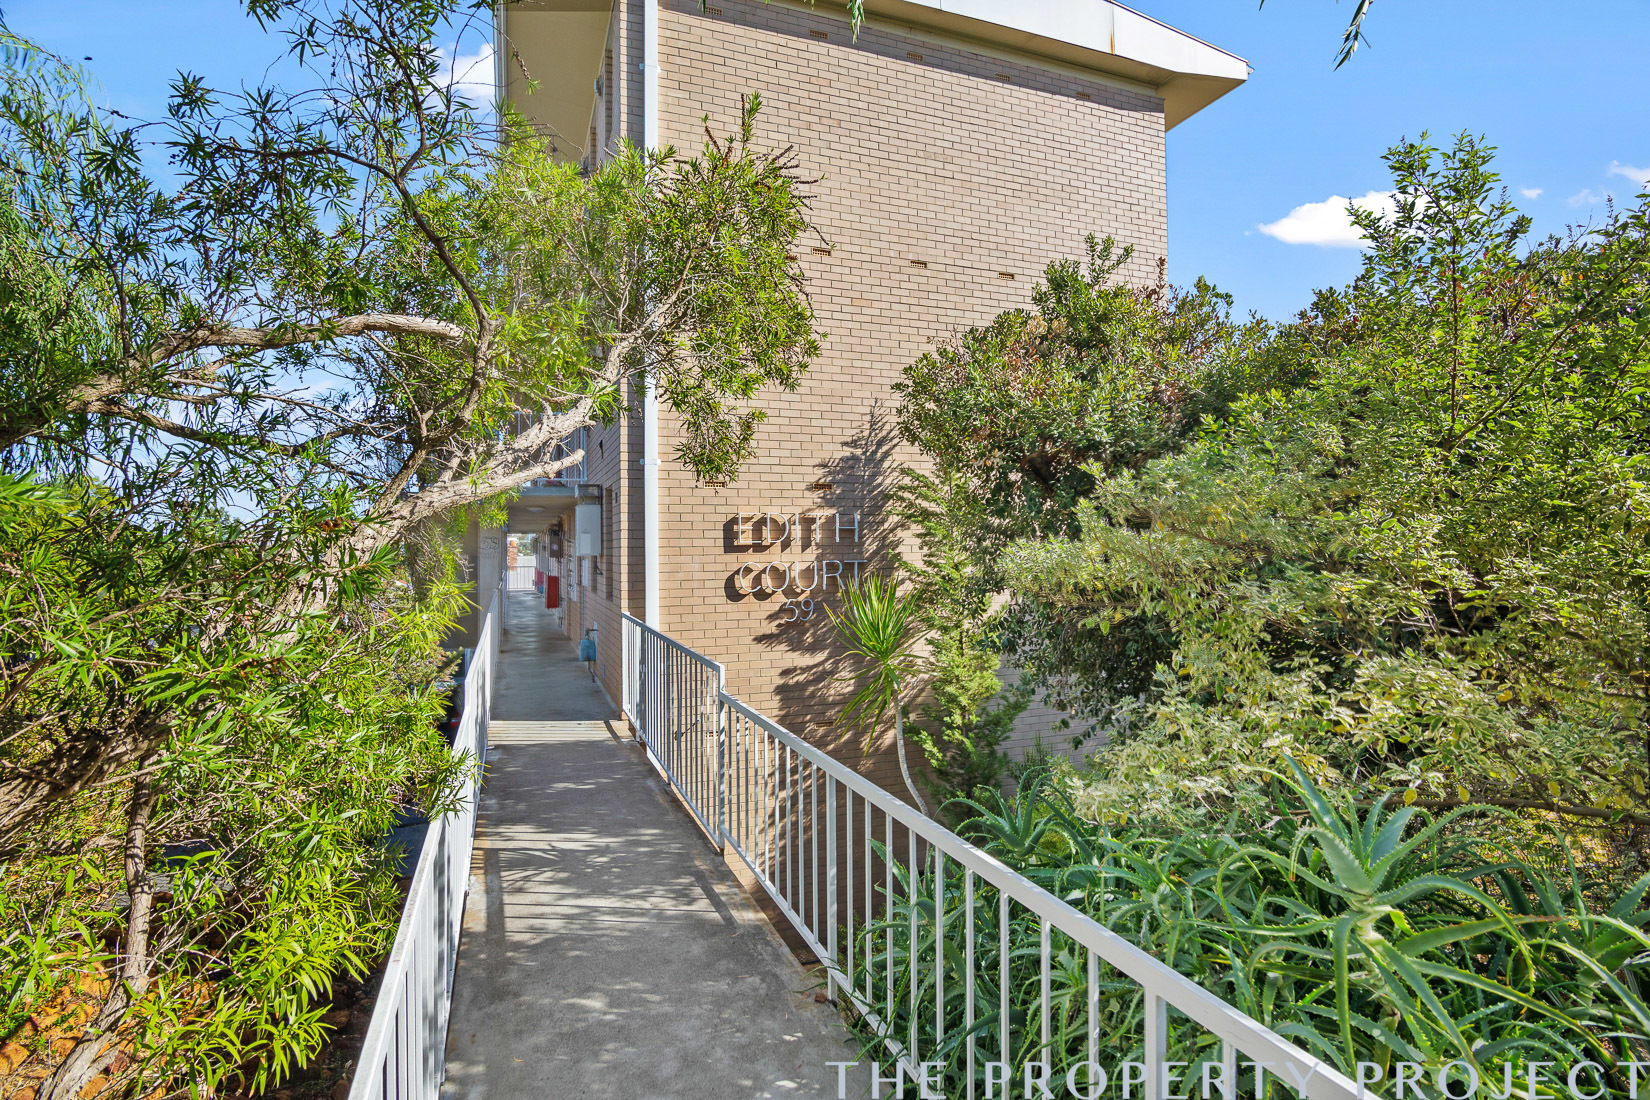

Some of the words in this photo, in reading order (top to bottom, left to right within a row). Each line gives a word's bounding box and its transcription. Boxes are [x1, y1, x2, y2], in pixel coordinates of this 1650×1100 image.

[738, 512, 859, 543] EDITH
[738, 560, 868, 592] COURT
[784, 598, 814, 622] 59
